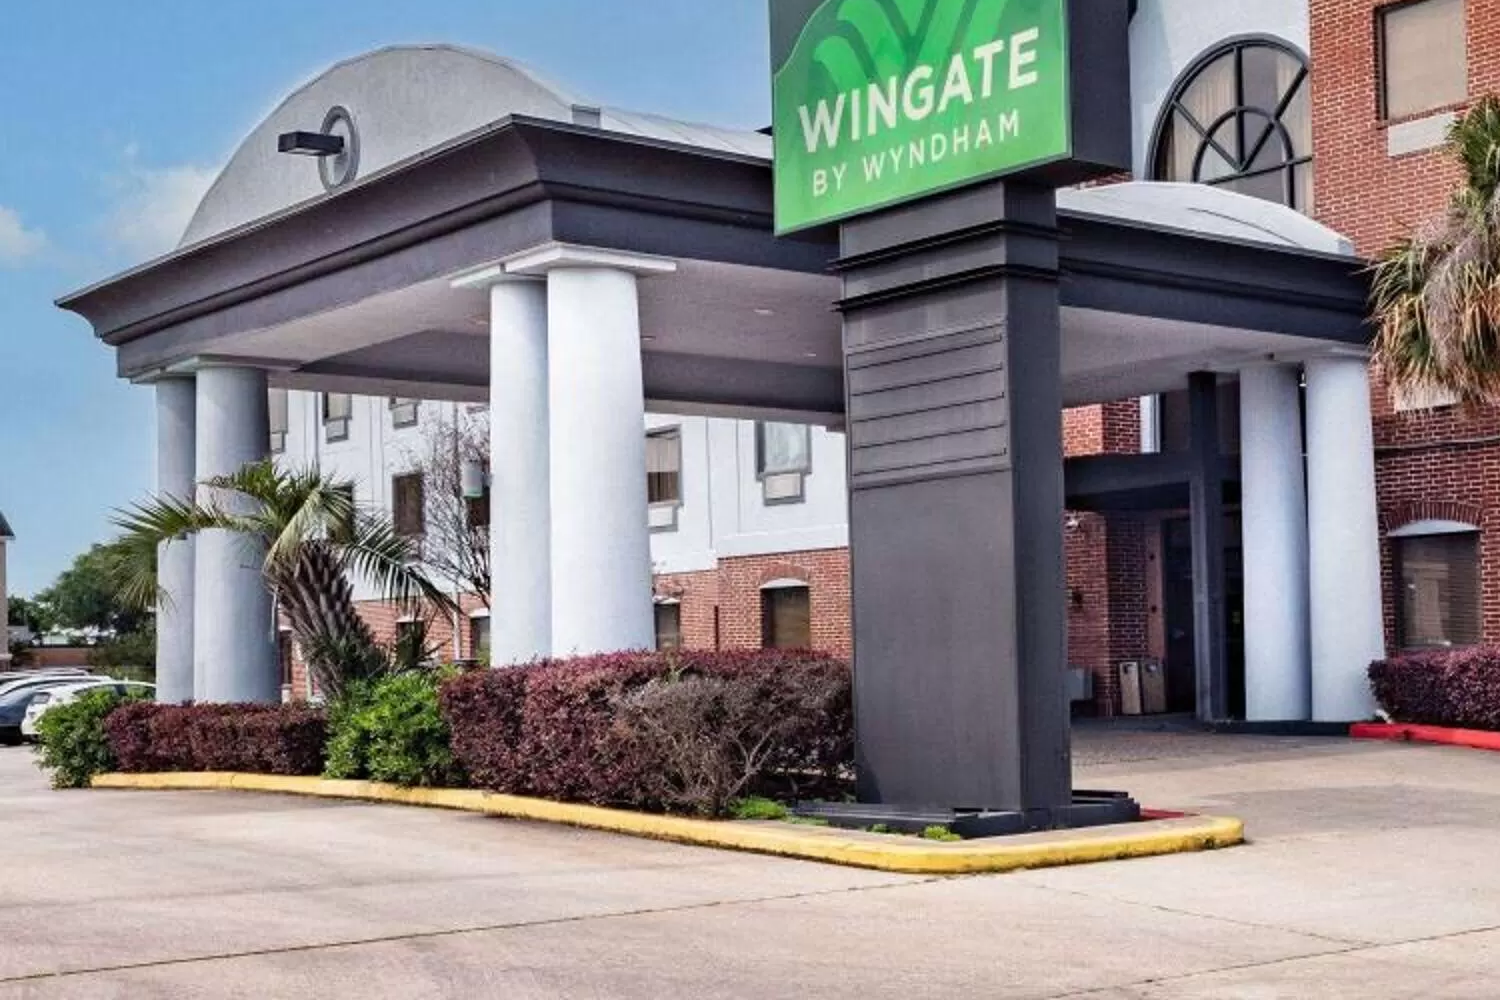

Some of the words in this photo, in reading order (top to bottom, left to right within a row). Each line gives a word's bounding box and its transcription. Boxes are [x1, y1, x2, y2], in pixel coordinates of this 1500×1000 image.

[798, 27, 1039, 153] WINGATE
[813, 163, 847, 197] BY
[862, 108, 1020, 183] WYNDHAM
